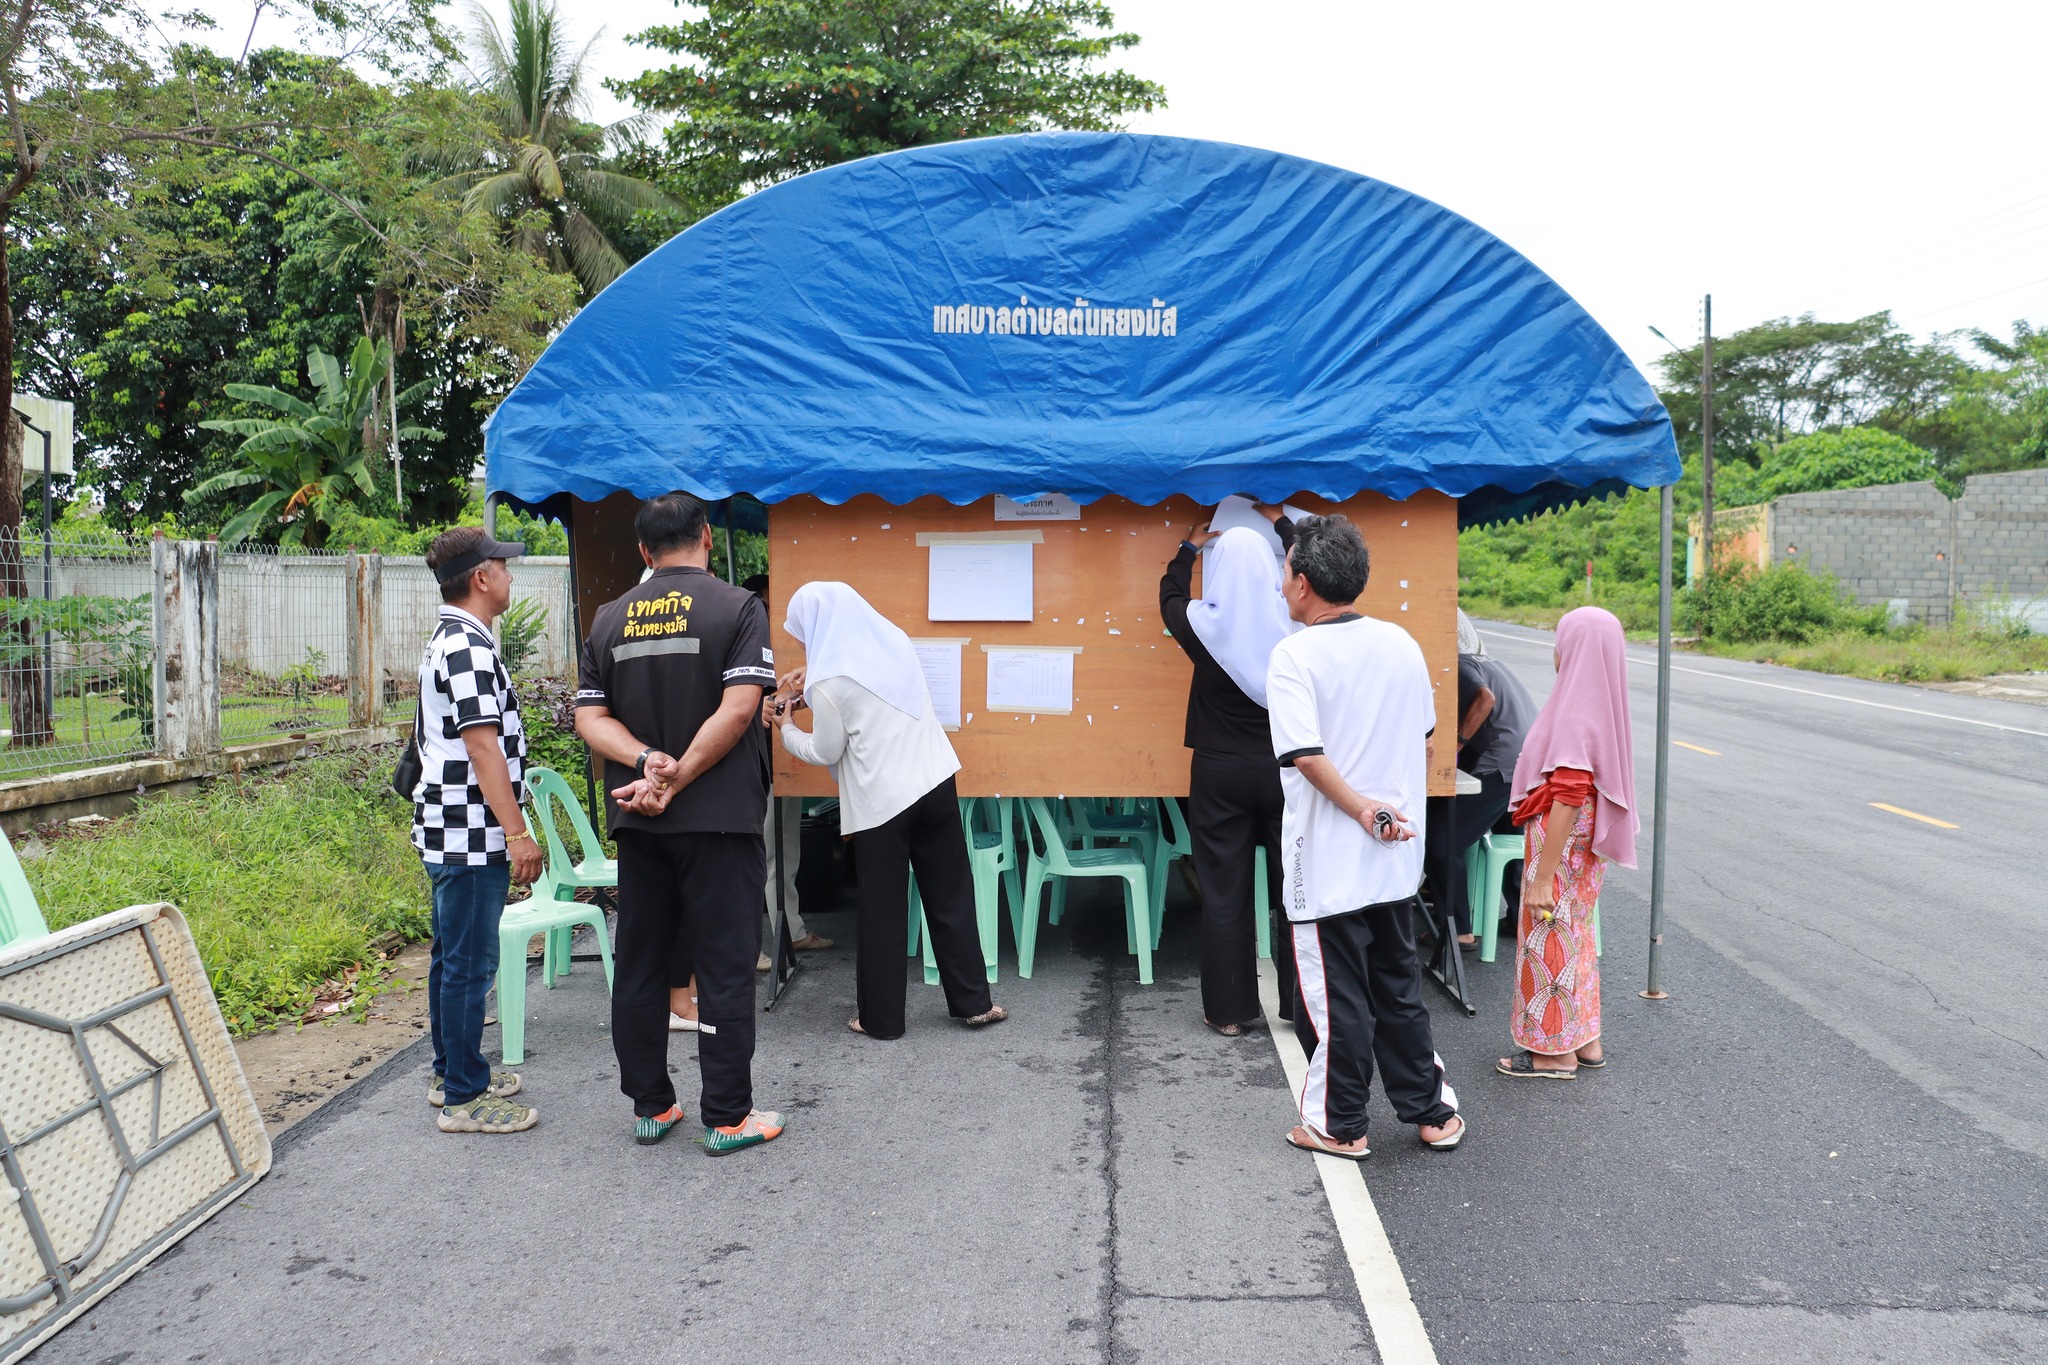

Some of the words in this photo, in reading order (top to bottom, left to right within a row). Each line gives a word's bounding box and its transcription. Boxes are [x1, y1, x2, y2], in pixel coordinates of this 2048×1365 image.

[933, 295, 1178, 337] เทศบาลตำบลตันหยงมัส
[626, 591, 693, 618] เทศกิจ
[624, 616, 687, 638] ตันหยงมัส
